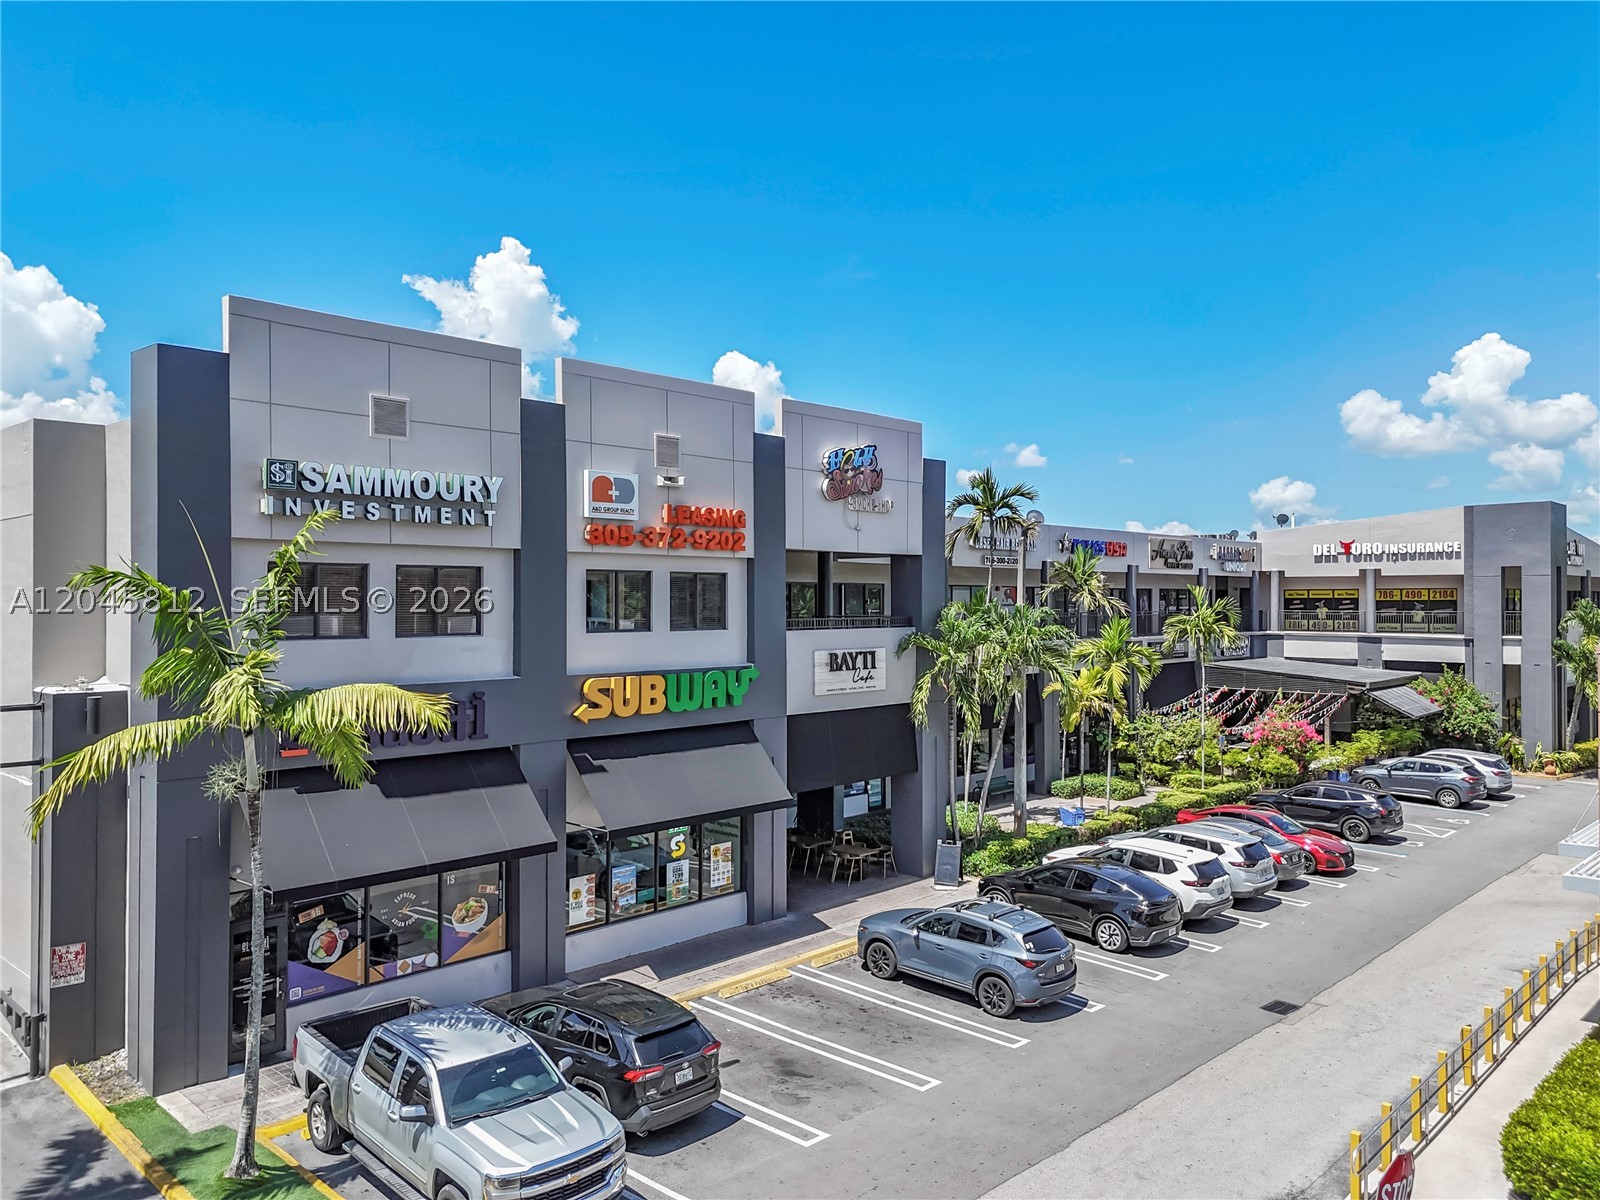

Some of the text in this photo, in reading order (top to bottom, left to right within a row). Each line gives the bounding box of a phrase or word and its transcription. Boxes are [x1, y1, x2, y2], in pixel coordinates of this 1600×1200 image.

[300, 461, 504, 504] SAMMOURY
[265, 495, 497, 527] INVESTMENT
[662, 503, 746, 529] LEASING
[584, 523, 746, 552] 305-372-9202
[1313, 544, 1337, 556] DEL
[1385, 541, 1461, 554] INSURANCE
[1378, 589, 1455, 599] 786- 490- 2184
[828, 651, 877, 672] BAYTI
[573, 669, 760, 724] SUBWAY
[394, 892, 416, 903] EXPRESS
[62, 951, 76, 962] ZONE
[1381, 1175, 1412, 1200] STOP
